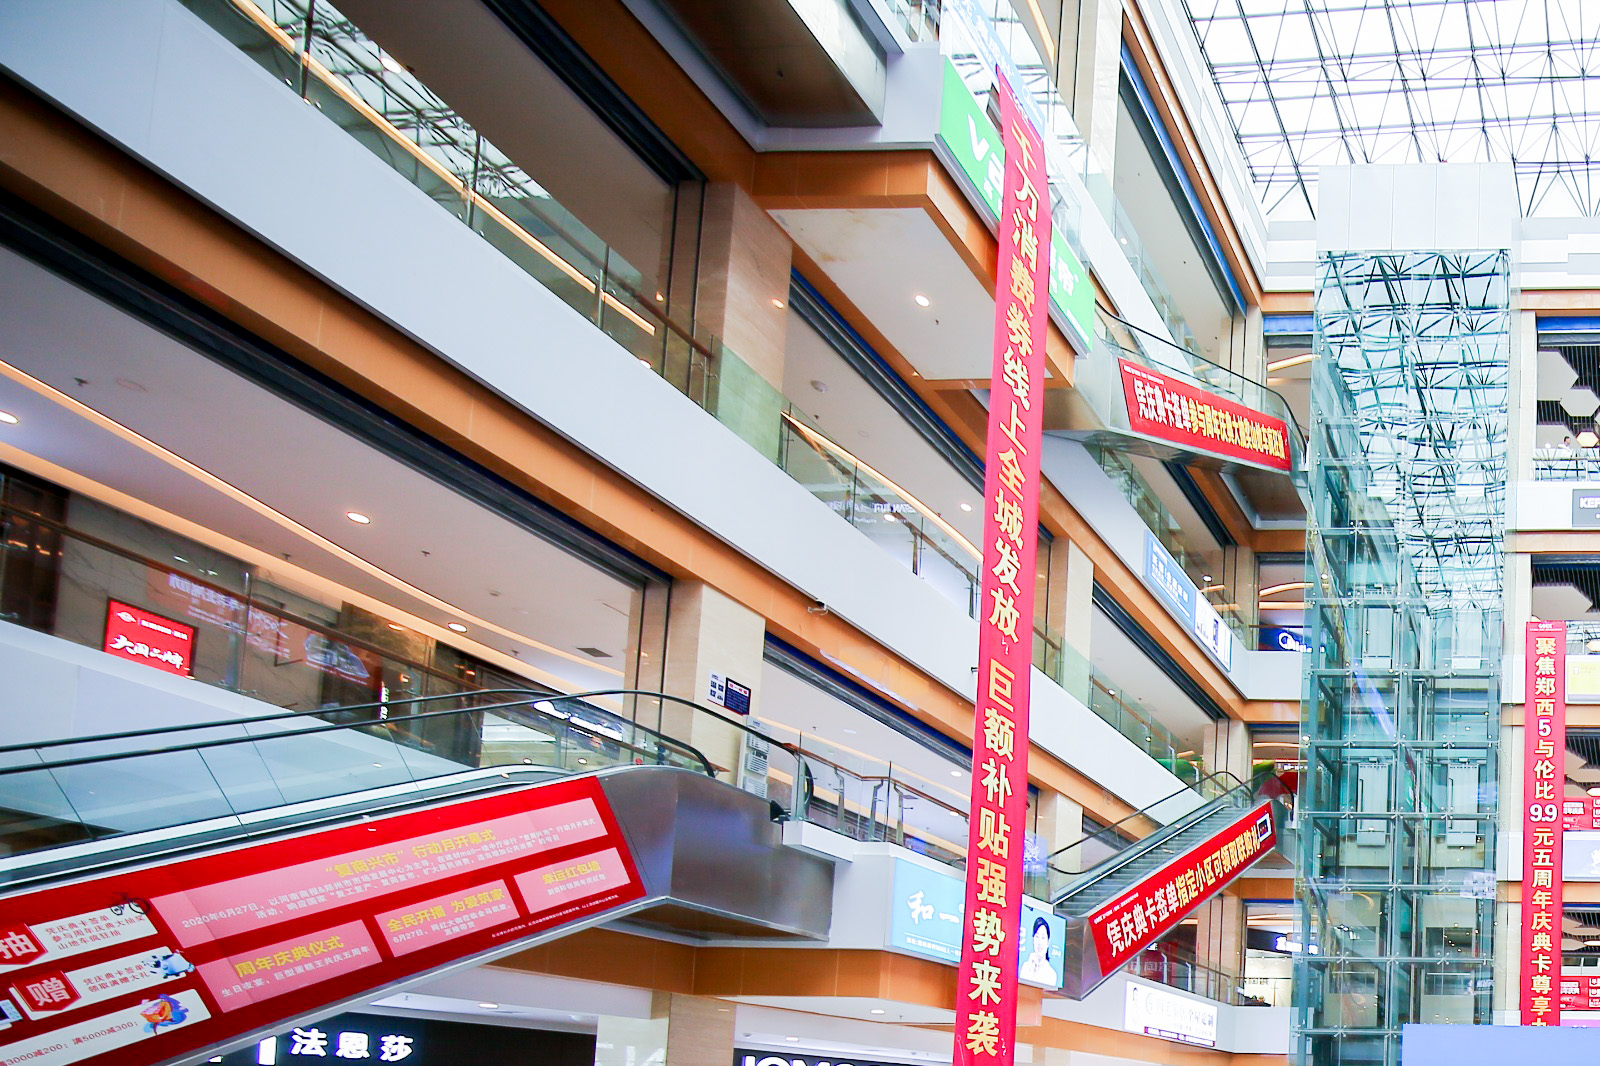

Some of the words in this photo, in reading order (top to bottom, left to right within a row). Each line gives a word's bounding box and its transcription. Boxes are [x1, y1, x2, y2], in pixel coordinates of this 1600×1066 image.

[966, 658, 1016, 1058] 巨额补贴强势来袭
[0, 931, 38, 960] 抽
[234, 935, 345, 978] 周年庆典仪式
[26, 976, 72, 1007] 赠
[291, 1027, 414, 1062] 法恩莎
